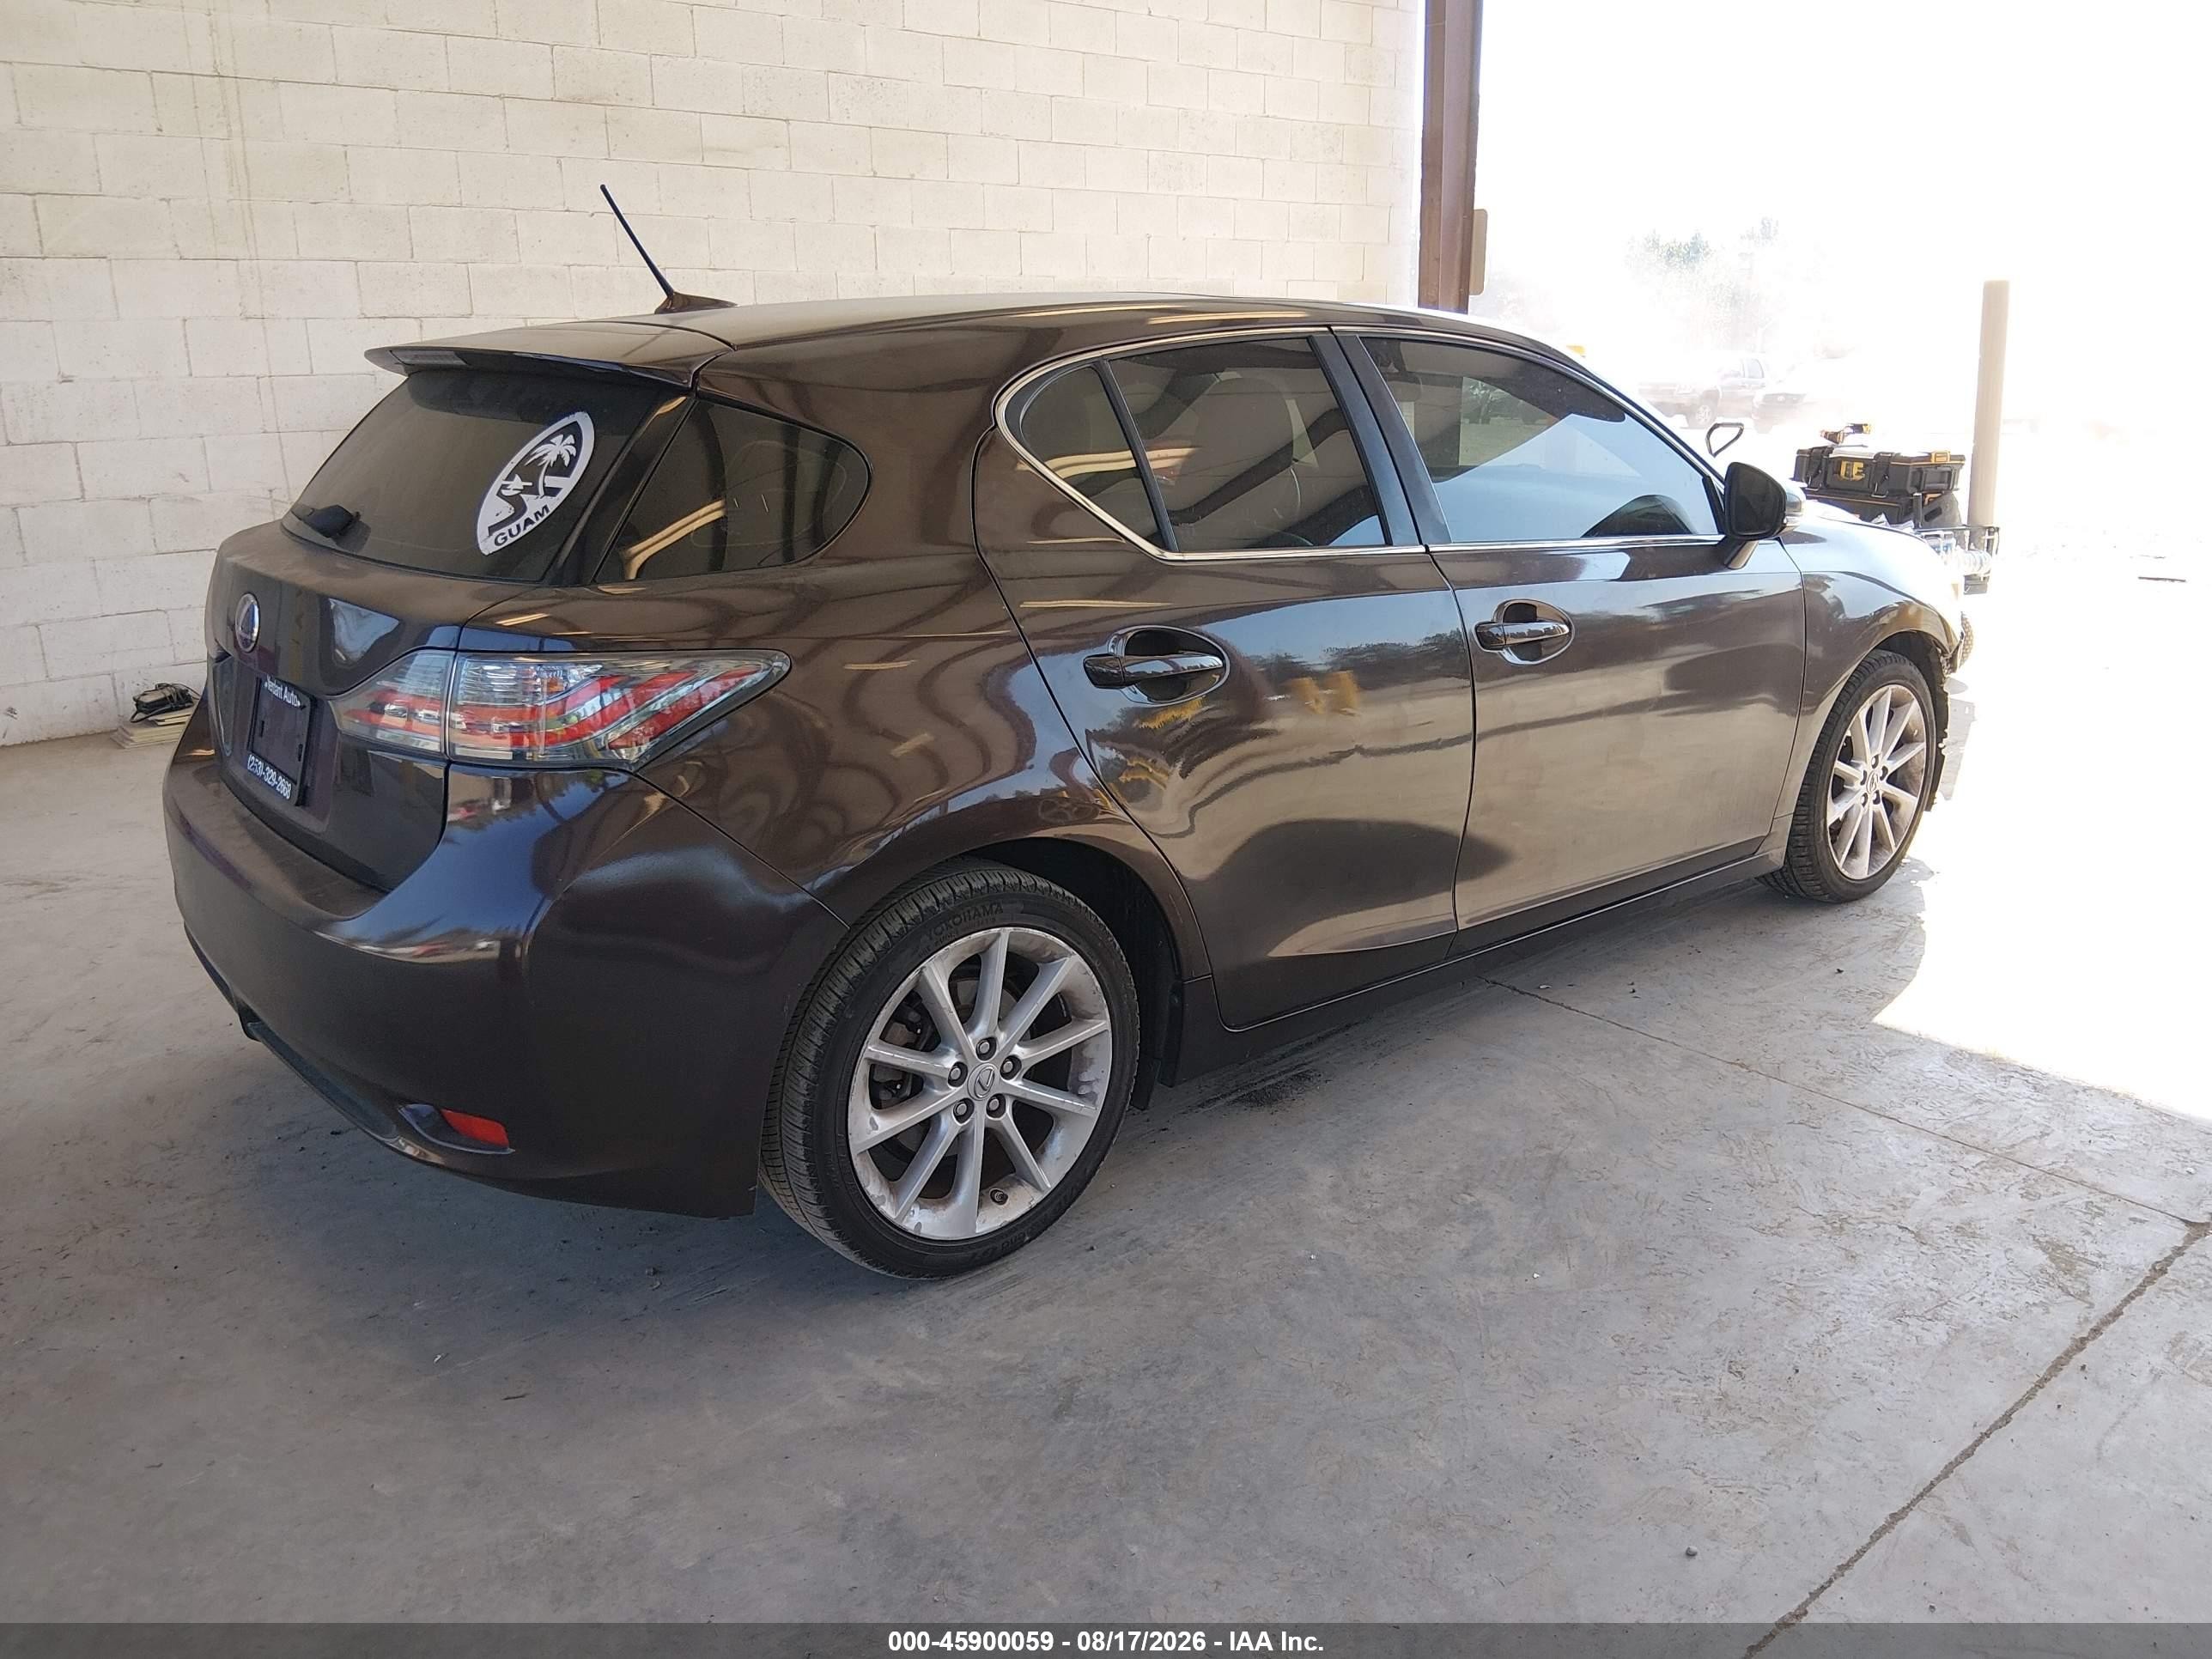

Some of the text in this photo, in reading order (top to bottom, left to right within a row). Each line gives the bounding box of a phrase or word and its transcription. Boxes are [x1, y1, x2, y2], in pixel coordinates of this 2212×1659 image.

[494, 504, 550, 547] GUAM
[283, 686, 298, 707] Auto
[928, 902, 1004, 941] YOKOHAMA
